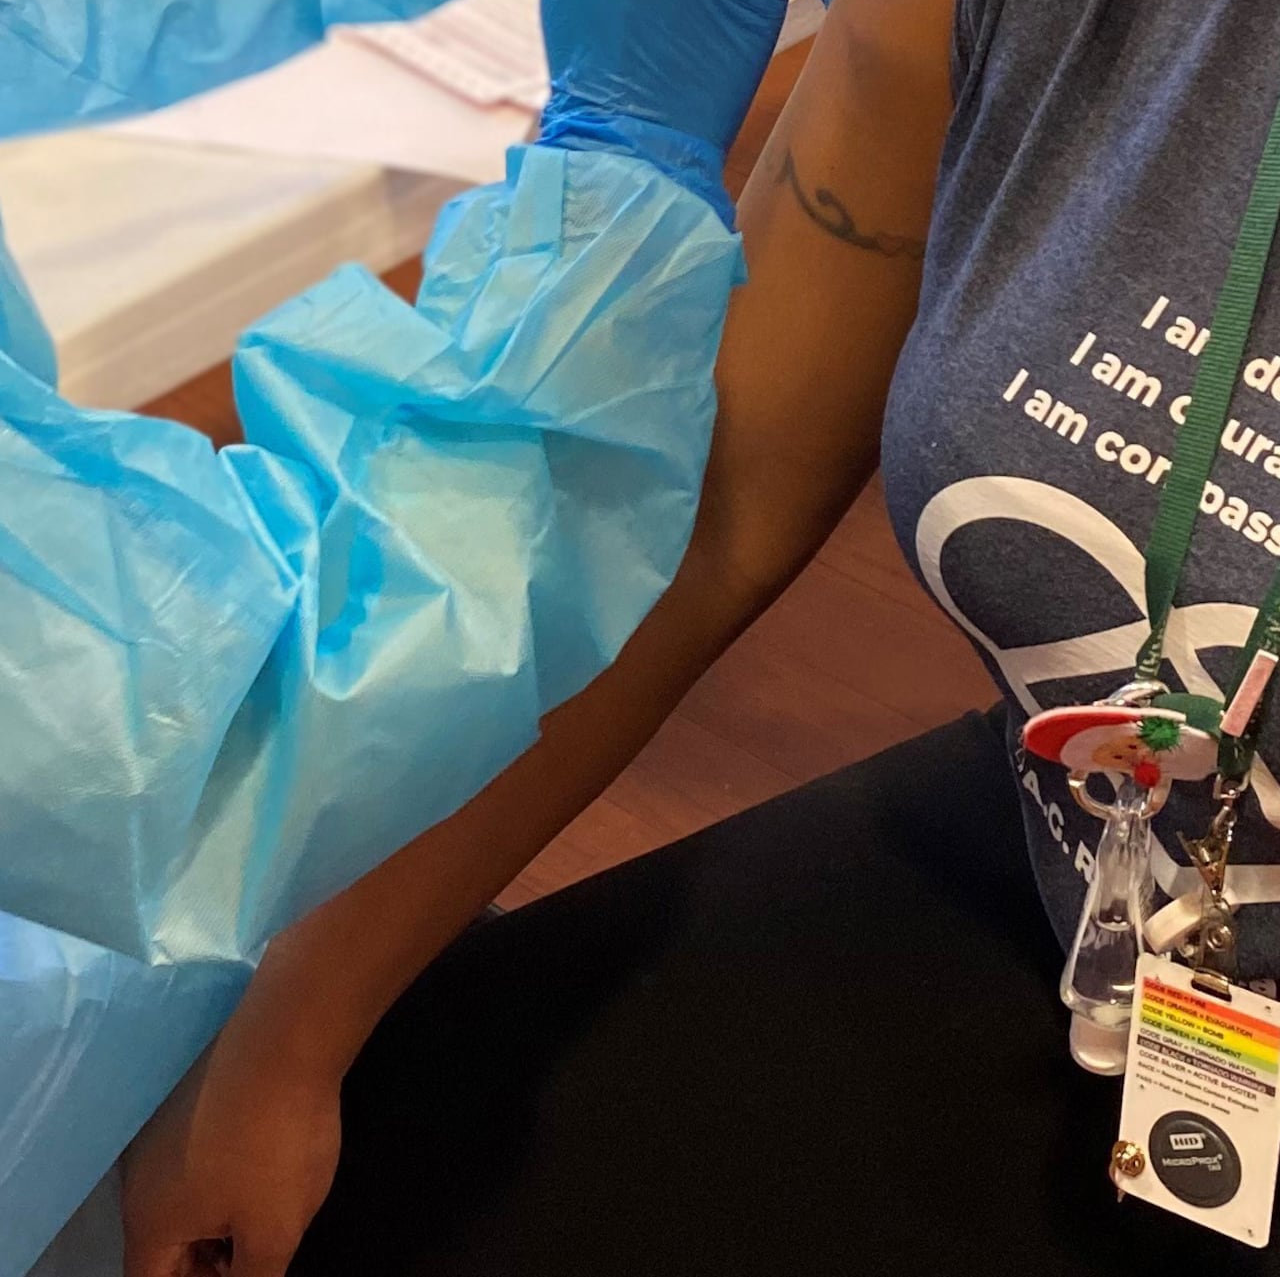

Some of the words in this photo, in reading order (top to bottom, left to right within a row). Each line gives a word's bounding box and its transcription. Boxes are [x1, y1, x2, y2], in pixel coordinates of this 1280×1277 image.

[1140, 295, 1170, 330] I
[1002, 367, 1030, 403] I
[1024, 388, 1089, 445] am
[1069, 331, 1097, 366] I
[1091, 352, 1163, 408] am
